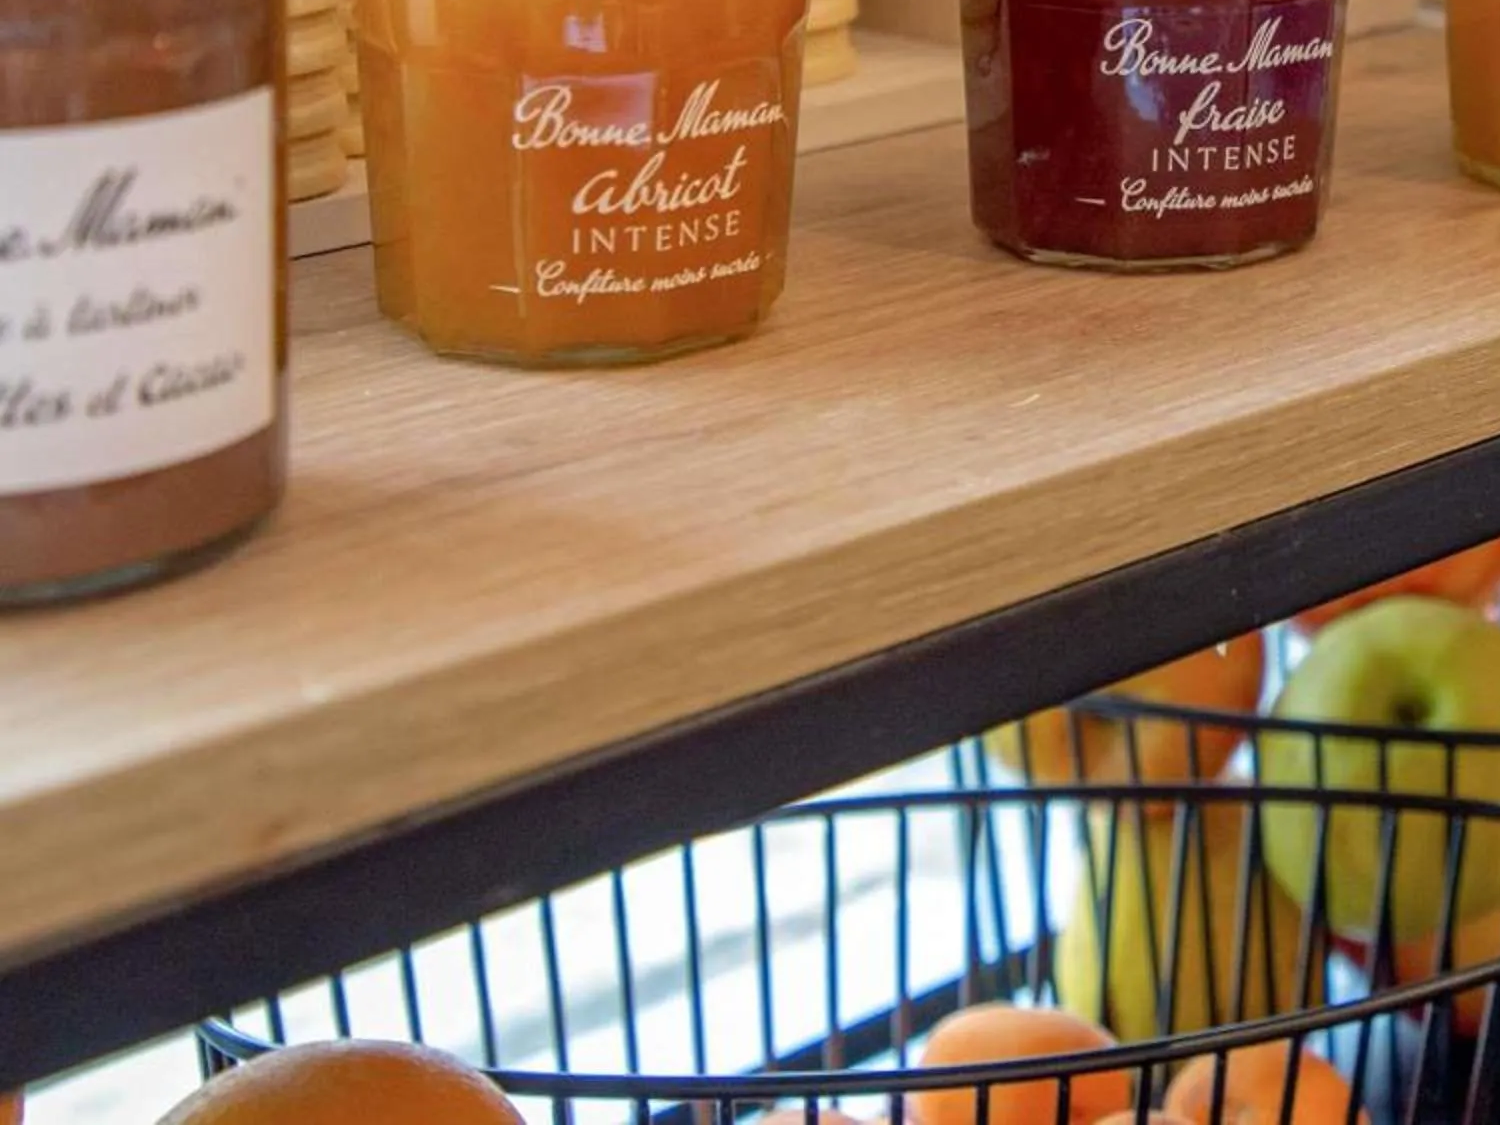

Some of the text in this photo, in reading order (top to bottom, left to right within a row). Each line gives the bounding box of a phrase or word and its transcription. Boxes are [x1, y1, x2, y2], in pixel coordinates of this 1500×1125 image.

[1100, 16, 1333, 75] Bonne Maman
[512, 79, 788, 149] Bonne Maman
[1152, 134, 1297, 172] INTENSE
[1120, 176, 1217, 219] Confiture
[1219, 187, 1270, 210] moins
[571, 210, 742, 254] INTENSE
[535, 259, 647, 305] Confiture
[649, 266, 707, 293] moins
